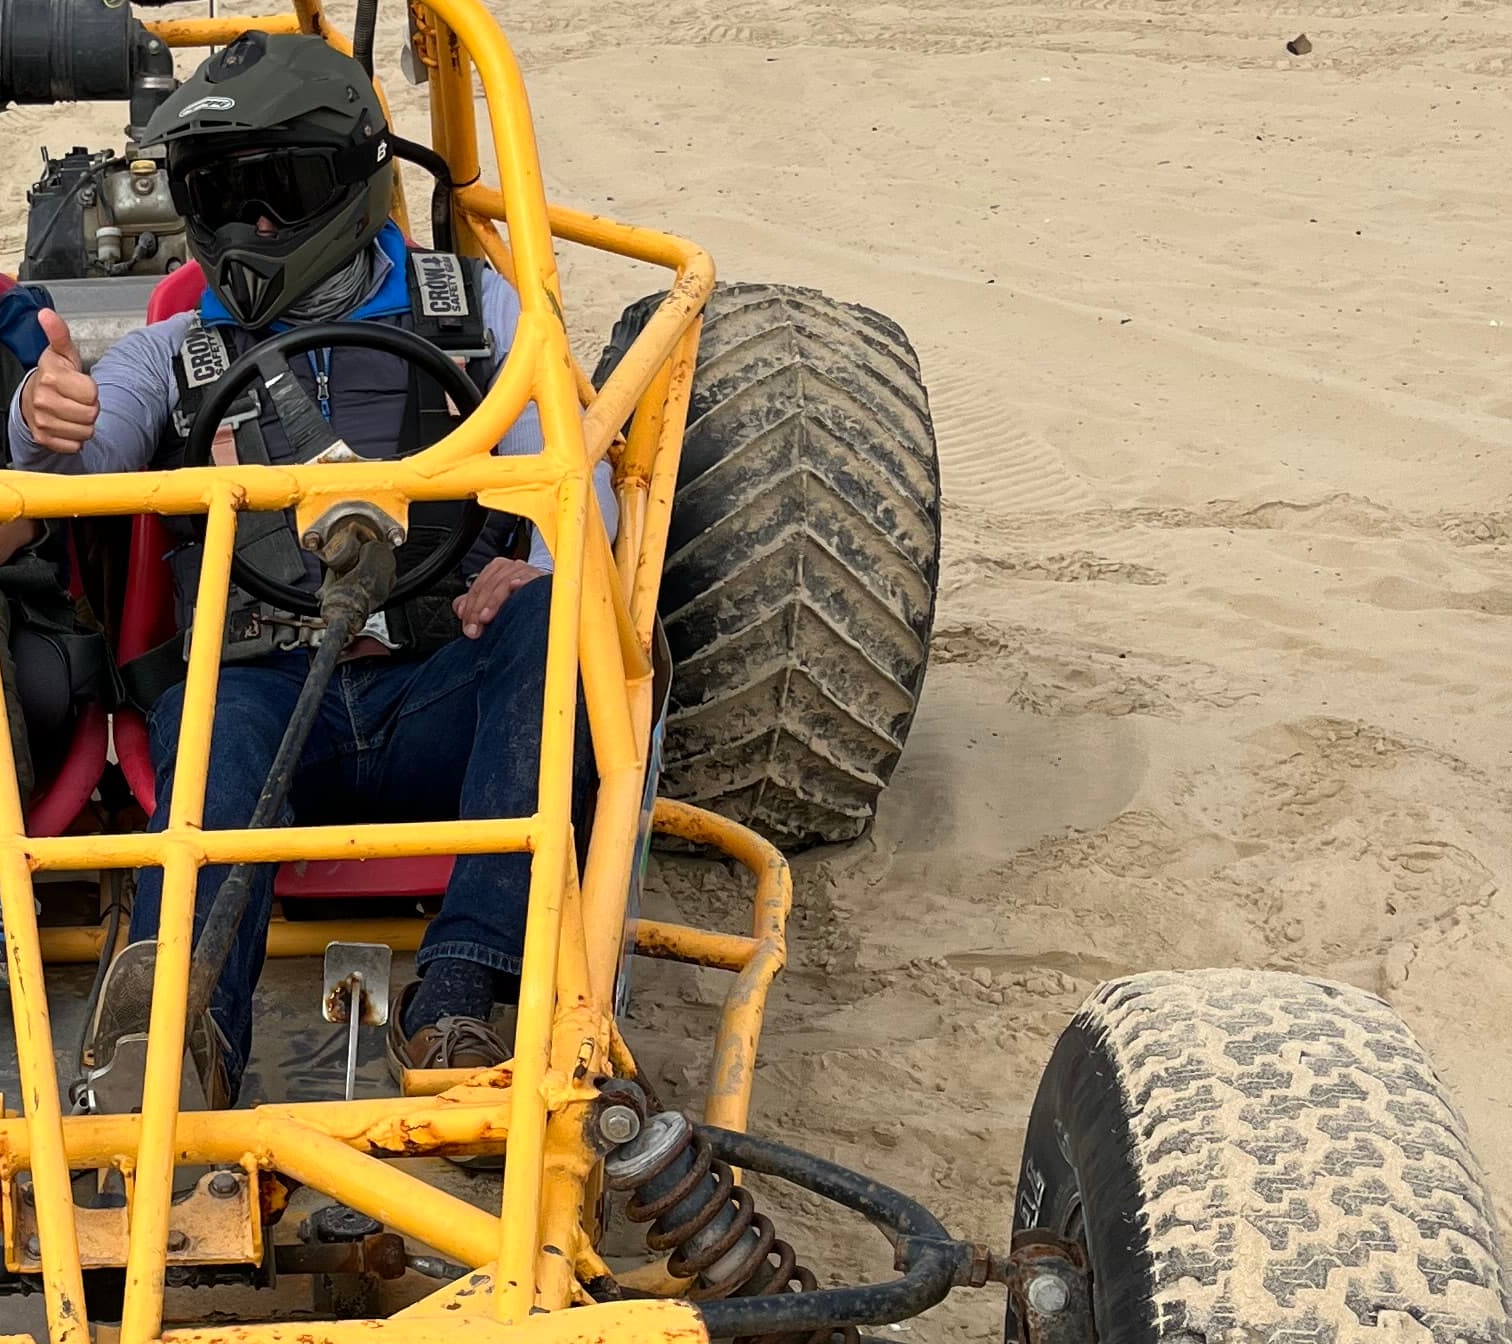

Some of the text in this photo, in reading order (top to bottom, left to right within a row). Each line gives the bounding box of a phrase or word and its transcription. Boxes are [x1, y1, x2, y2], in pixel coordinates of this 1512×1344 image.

[423, 267, 451, 312] CROW
[448, 273, 461, 312] SAFETY
[185, 327, 216, 381] CROW
[207, 334, 225, 376] SAFETY
